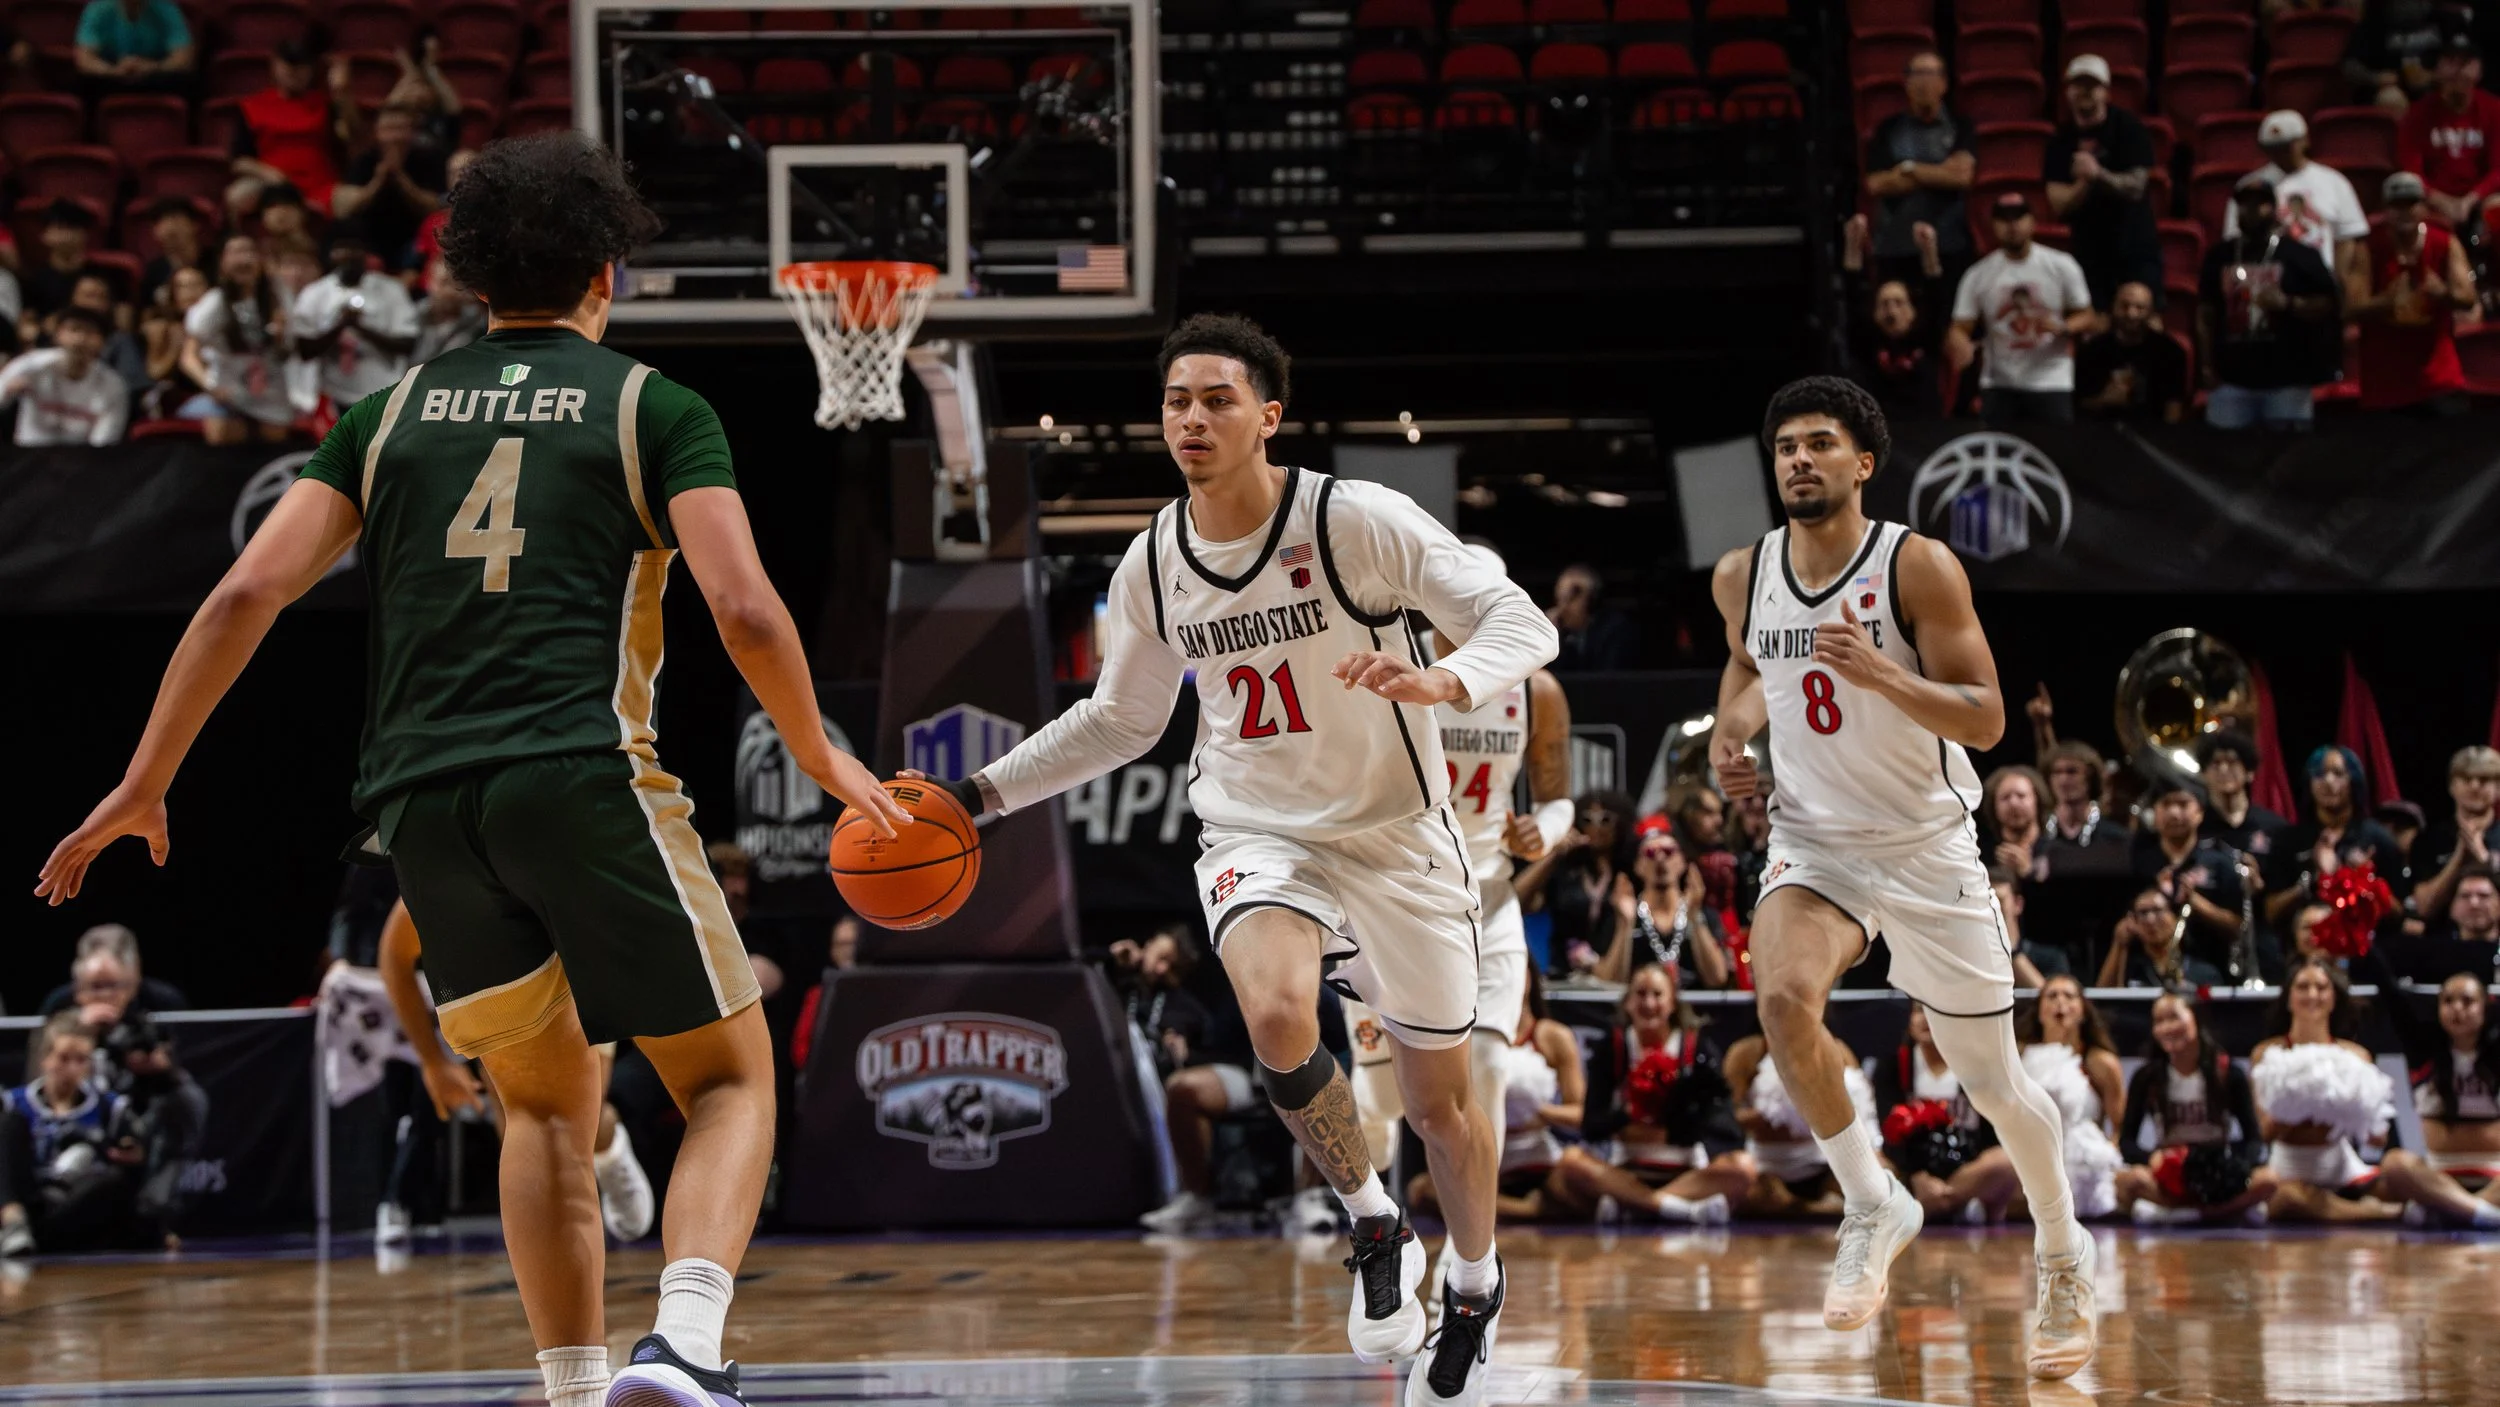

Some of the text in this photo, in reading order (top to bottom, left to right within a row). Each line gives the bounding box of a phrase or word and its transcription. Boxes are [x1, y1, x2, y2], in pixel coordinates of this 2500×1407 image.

[420, 388, 587, 423] BUTLER
[445, 437, 526, 592] 4
[1177, 598, 1329, 659] SAN DIEGO STATE
[1758, 630, 1780, 660] SAN
[1226, 658, 1312, 739] 21
[1802, 670, 1842, 735] 8
[1483, 730, 1519, 756] STATE
[858, 1022, 1062, 1088] OLD TRAPPER
